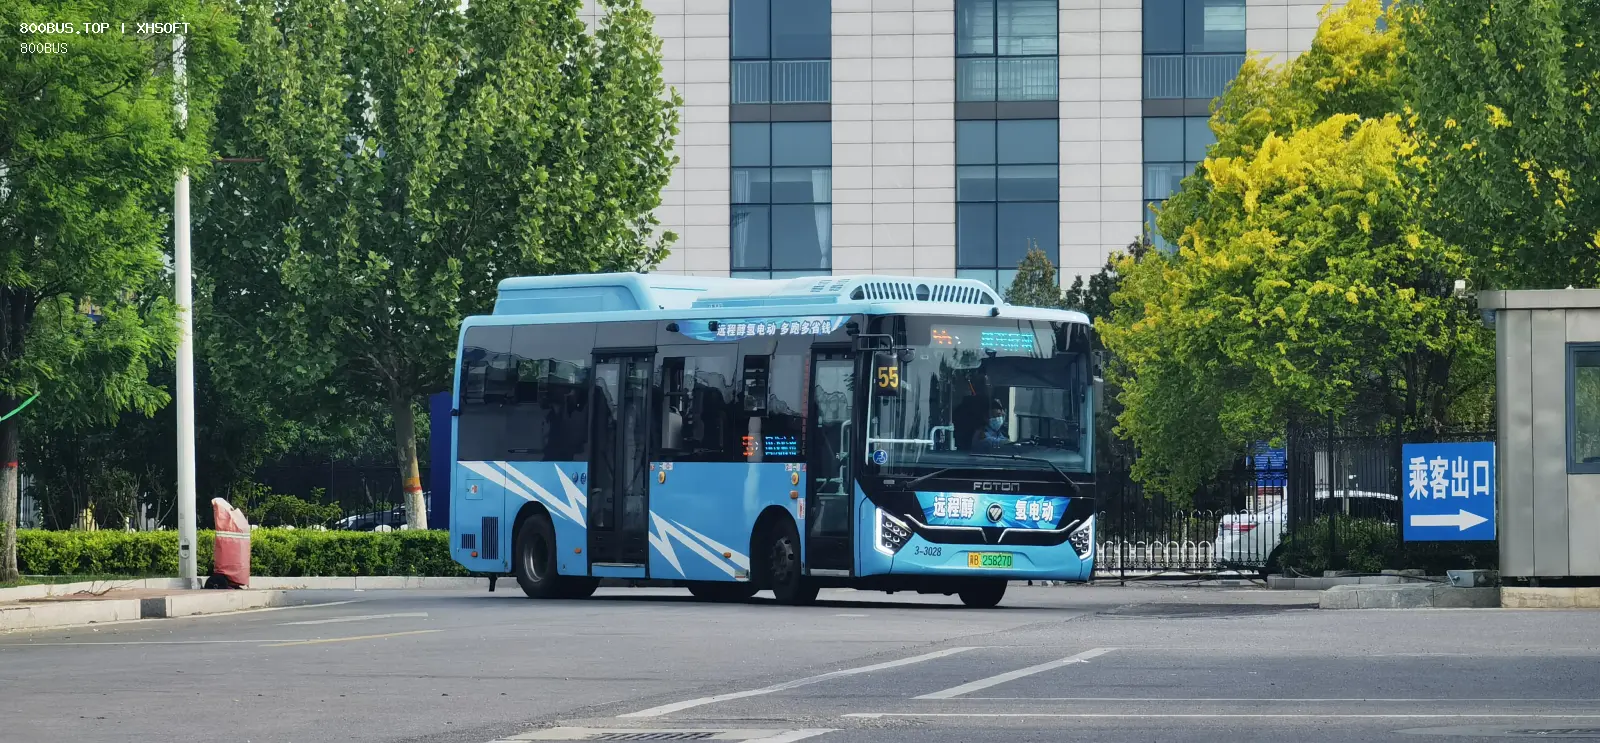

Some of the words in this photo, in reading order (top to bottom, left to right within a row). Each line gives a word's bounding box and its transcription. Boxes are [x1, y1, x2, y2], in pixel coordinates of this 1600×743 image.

[717, 323, 776, 336] 远程醇氢电动
[780, 320, 831, 335] 多跑多省钱
[878, 366, 899, 388] 55
[973, 481, 1020, 491] FOTON
[1408, 455, 1490, 500] 乘客出口
[933, 496, 975, 518] 远程醇
[1015, 500, 1053, 522] 氢电动
[914, 545, 942, 557] 3-3028
